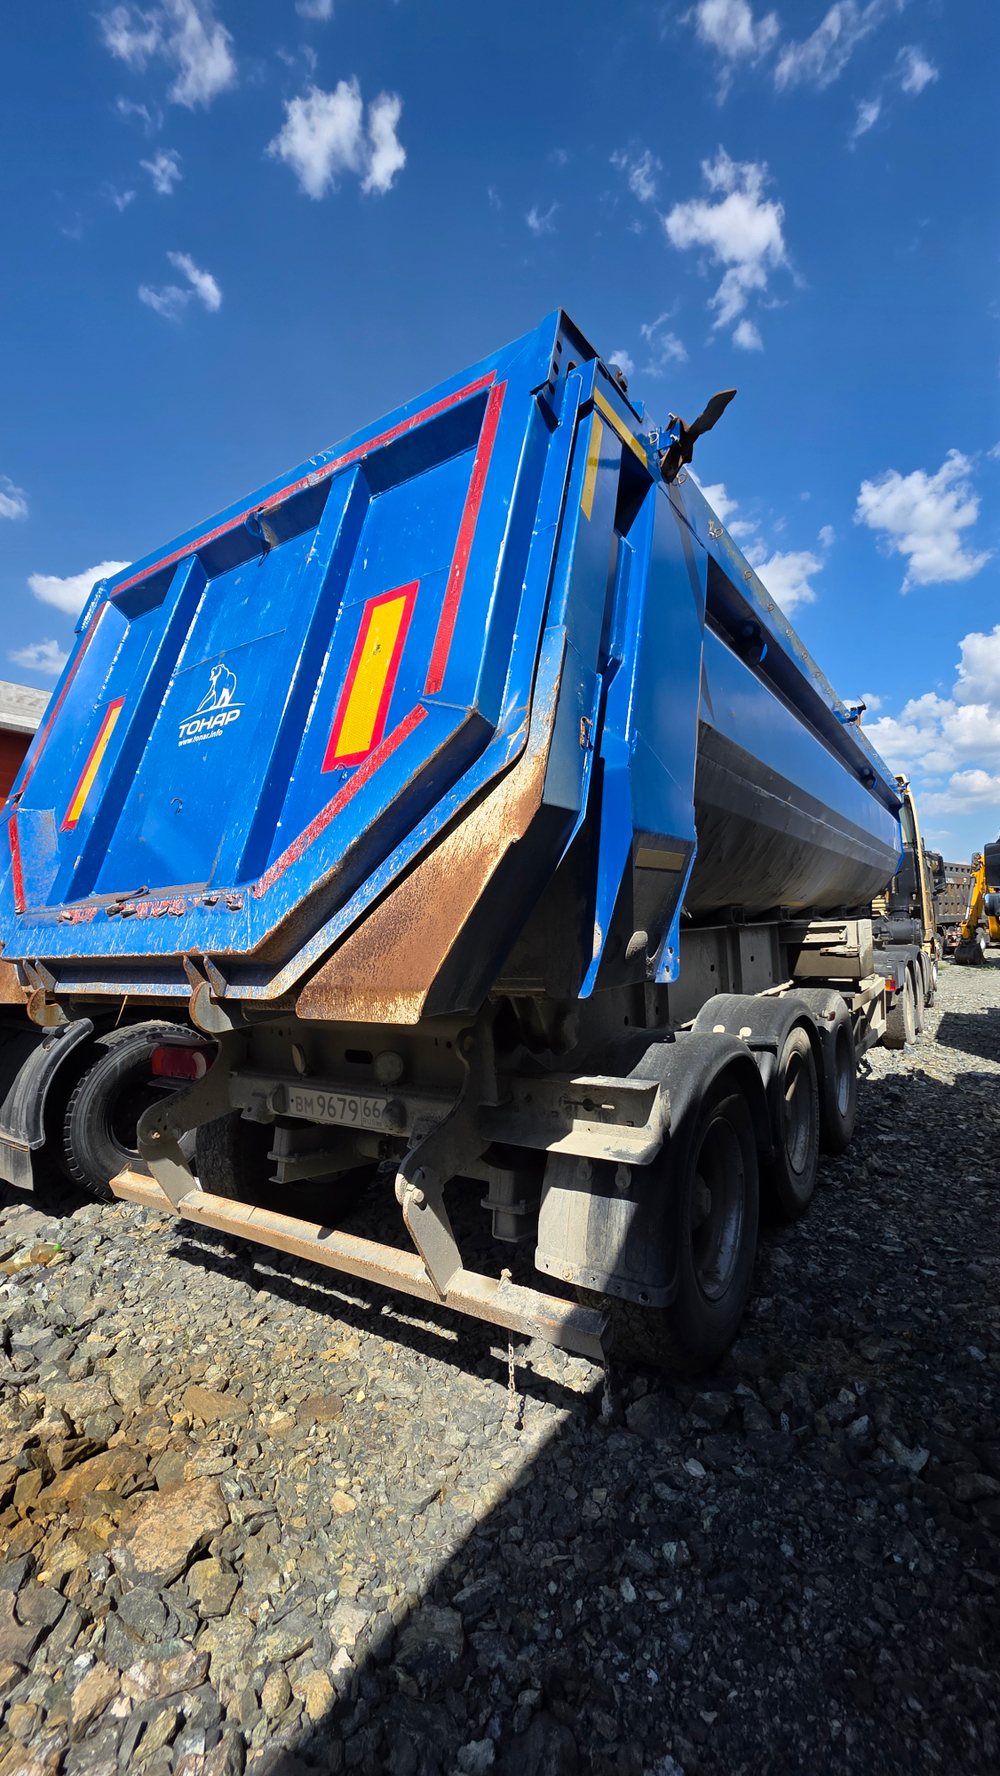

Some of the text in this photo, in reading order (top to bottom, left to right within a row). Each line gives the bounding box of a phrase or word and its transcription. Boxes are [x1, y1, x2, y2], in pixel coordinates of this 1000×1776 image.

[179, 709, 241, 738] ТОНАР
[178, 729, 223, 746] www.tonar.info
[363, 1117, 376, 1126] RUS
